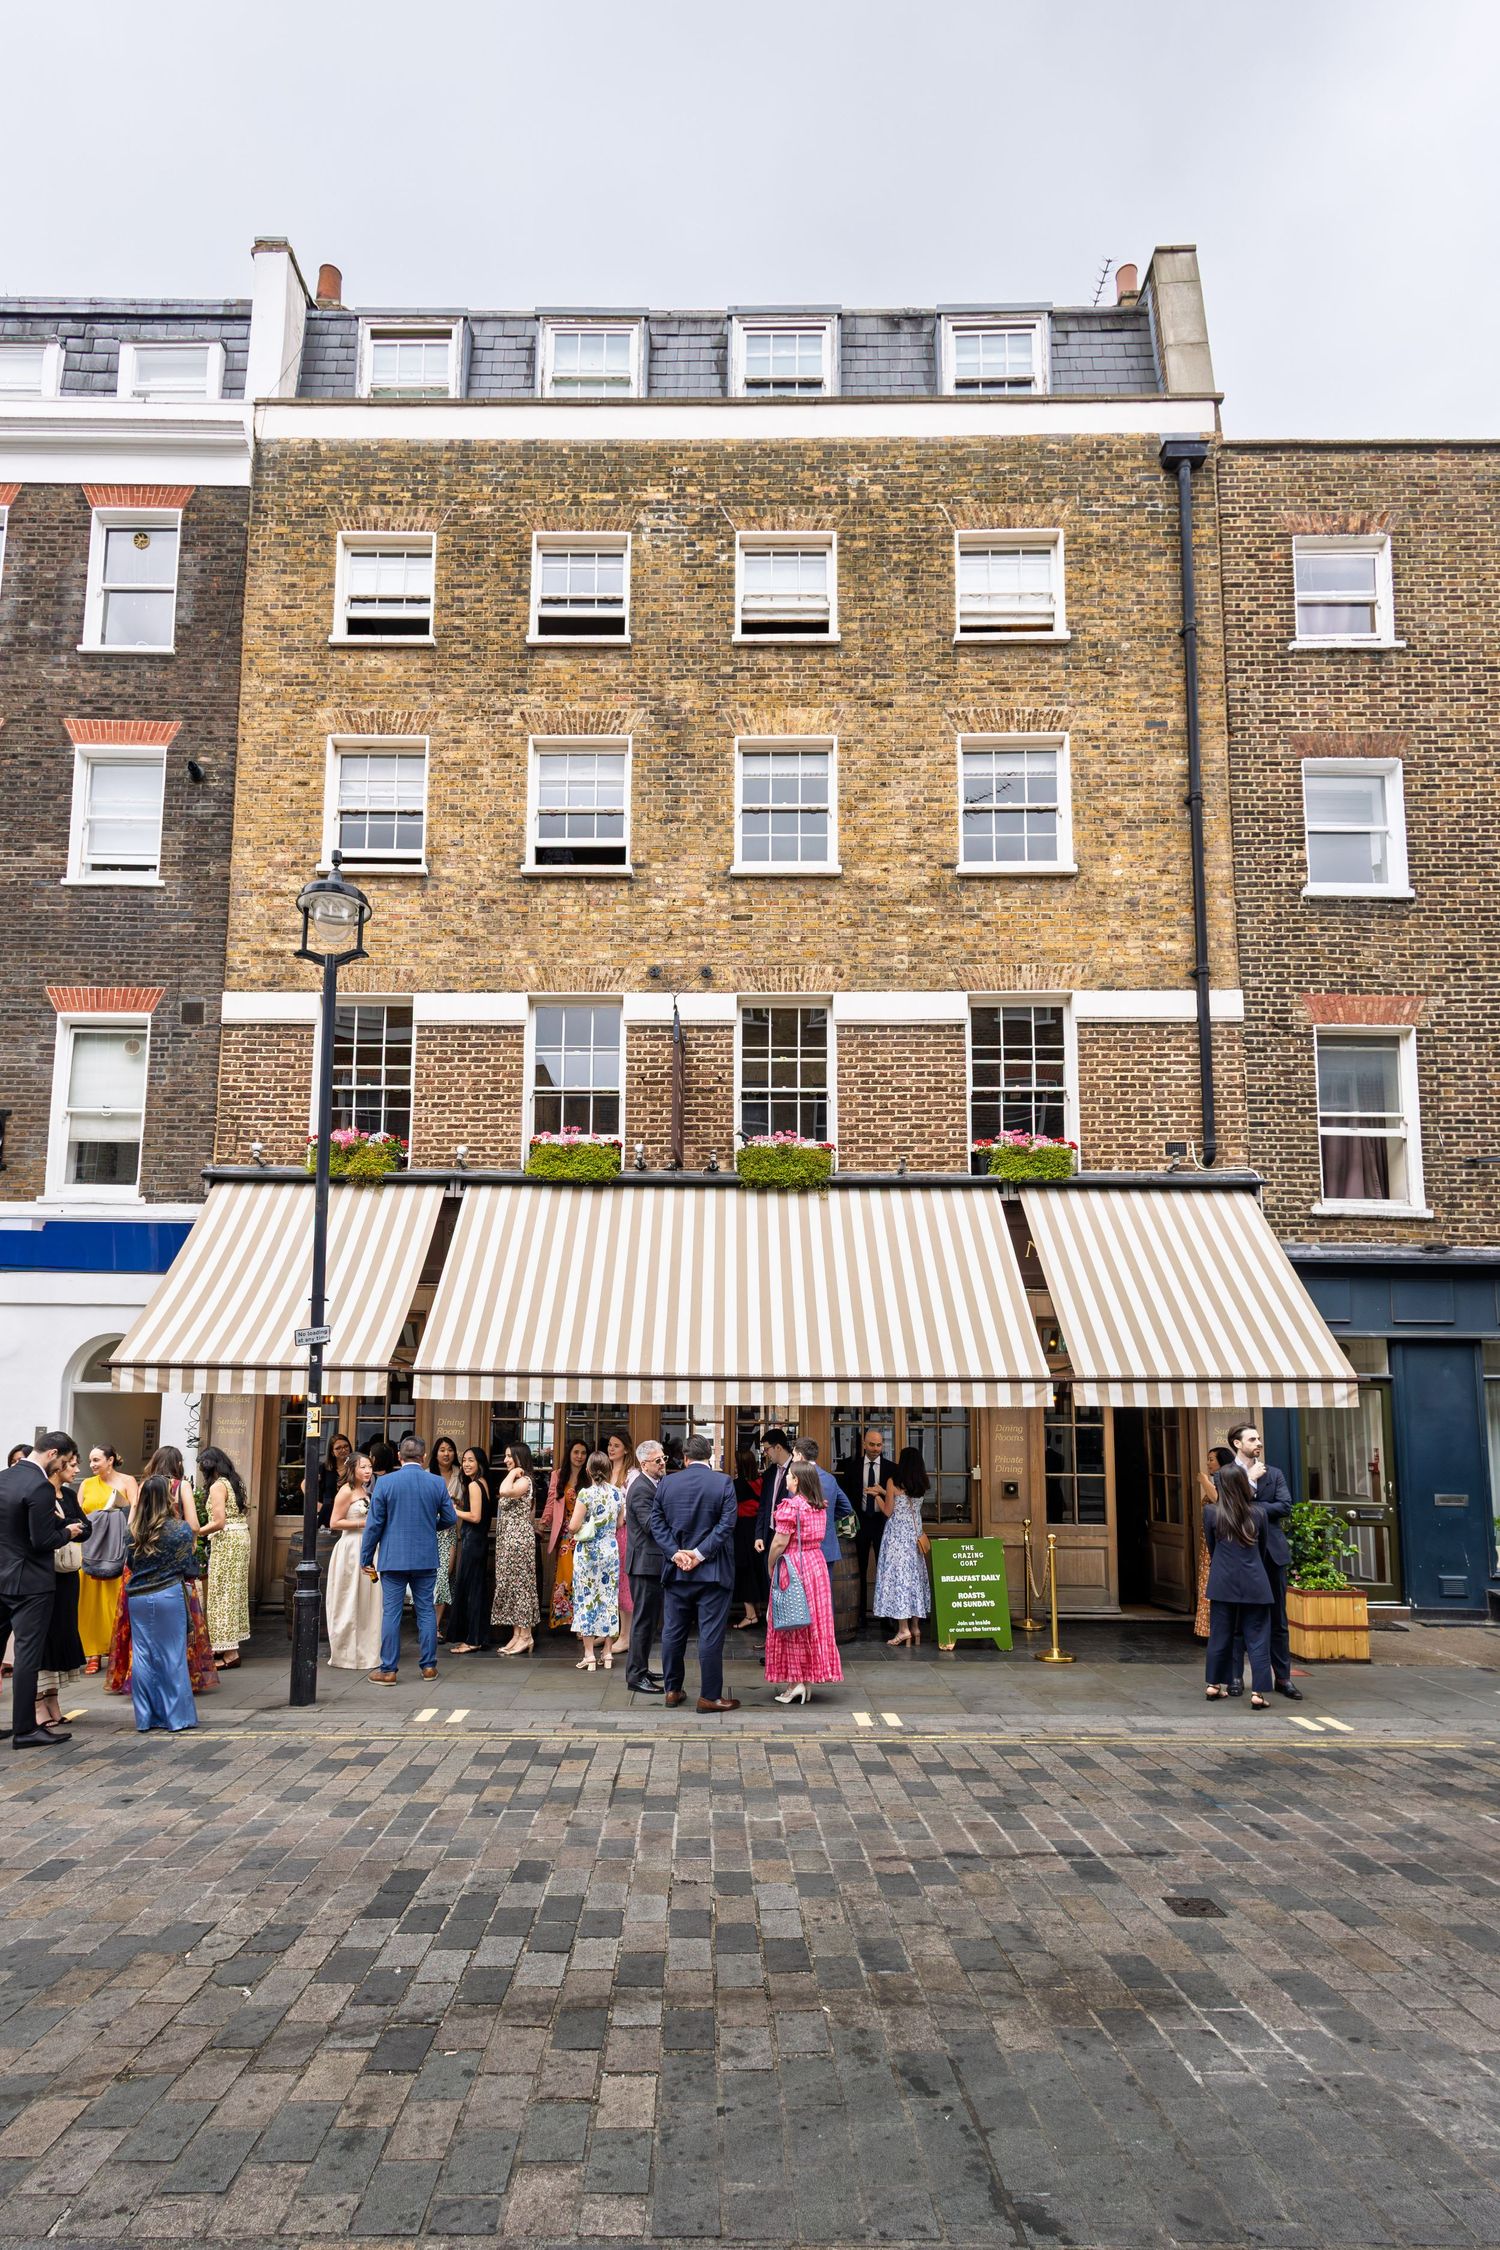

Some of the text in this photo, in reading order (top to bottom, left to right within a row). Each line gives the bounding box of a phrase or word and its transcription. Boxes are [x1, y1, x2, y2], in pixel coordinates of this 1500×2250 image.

[216, 1416, 247, 1427] Sunday
[437, 1418, 465, 1427] Dining
[216, 1426, 246, 1434] Roasts
[436, 1427, 465, 1435] Rooms
[995, 1424, 1023, 1434] Dining
[995, 1432, 1024, 1441] Rooms
[994, 1456, 1023, 1464] Private
[995, 1465, 1023, 1475] Dining
